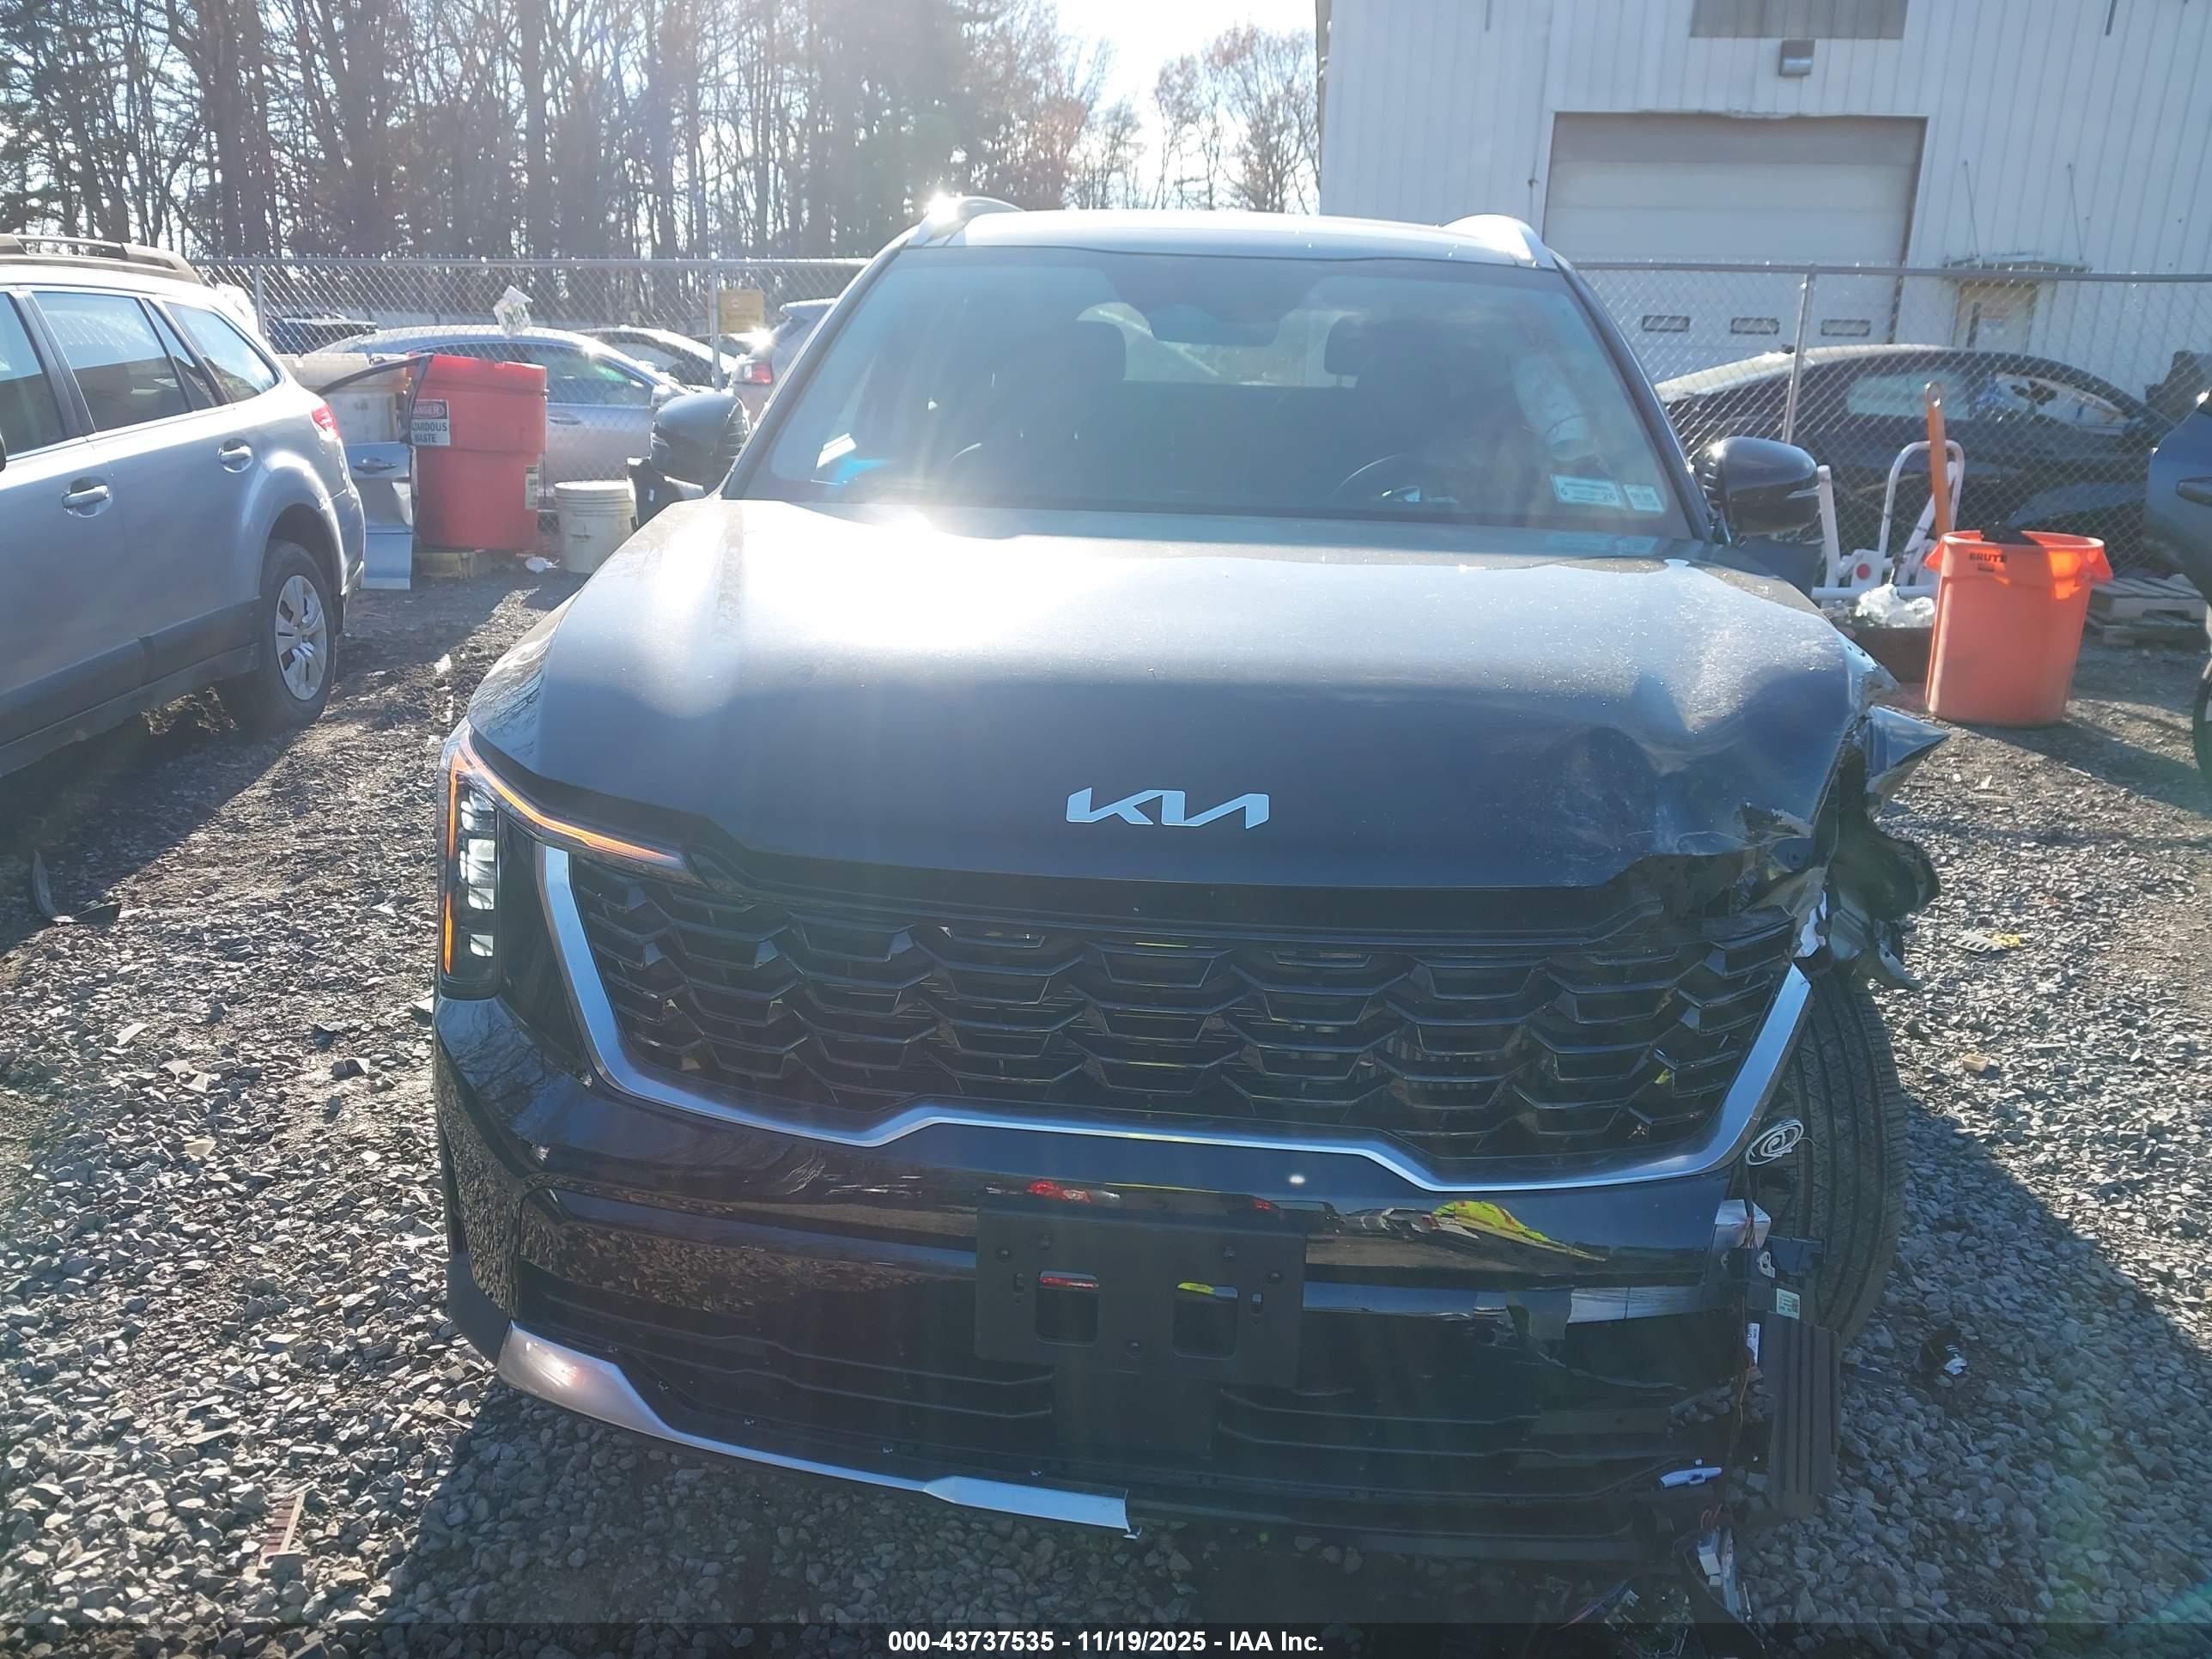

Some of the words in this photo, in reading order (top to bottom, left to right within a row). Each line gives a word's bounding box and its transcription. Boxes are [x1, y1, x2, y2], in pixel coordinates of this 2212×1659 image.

[412, 404, 440, 415] ANGER
[414, 432, 437, 443] WASTE
[1969, 552, 2007, 563] BRUTE
[1066, 787, 1269, 830] KIA
